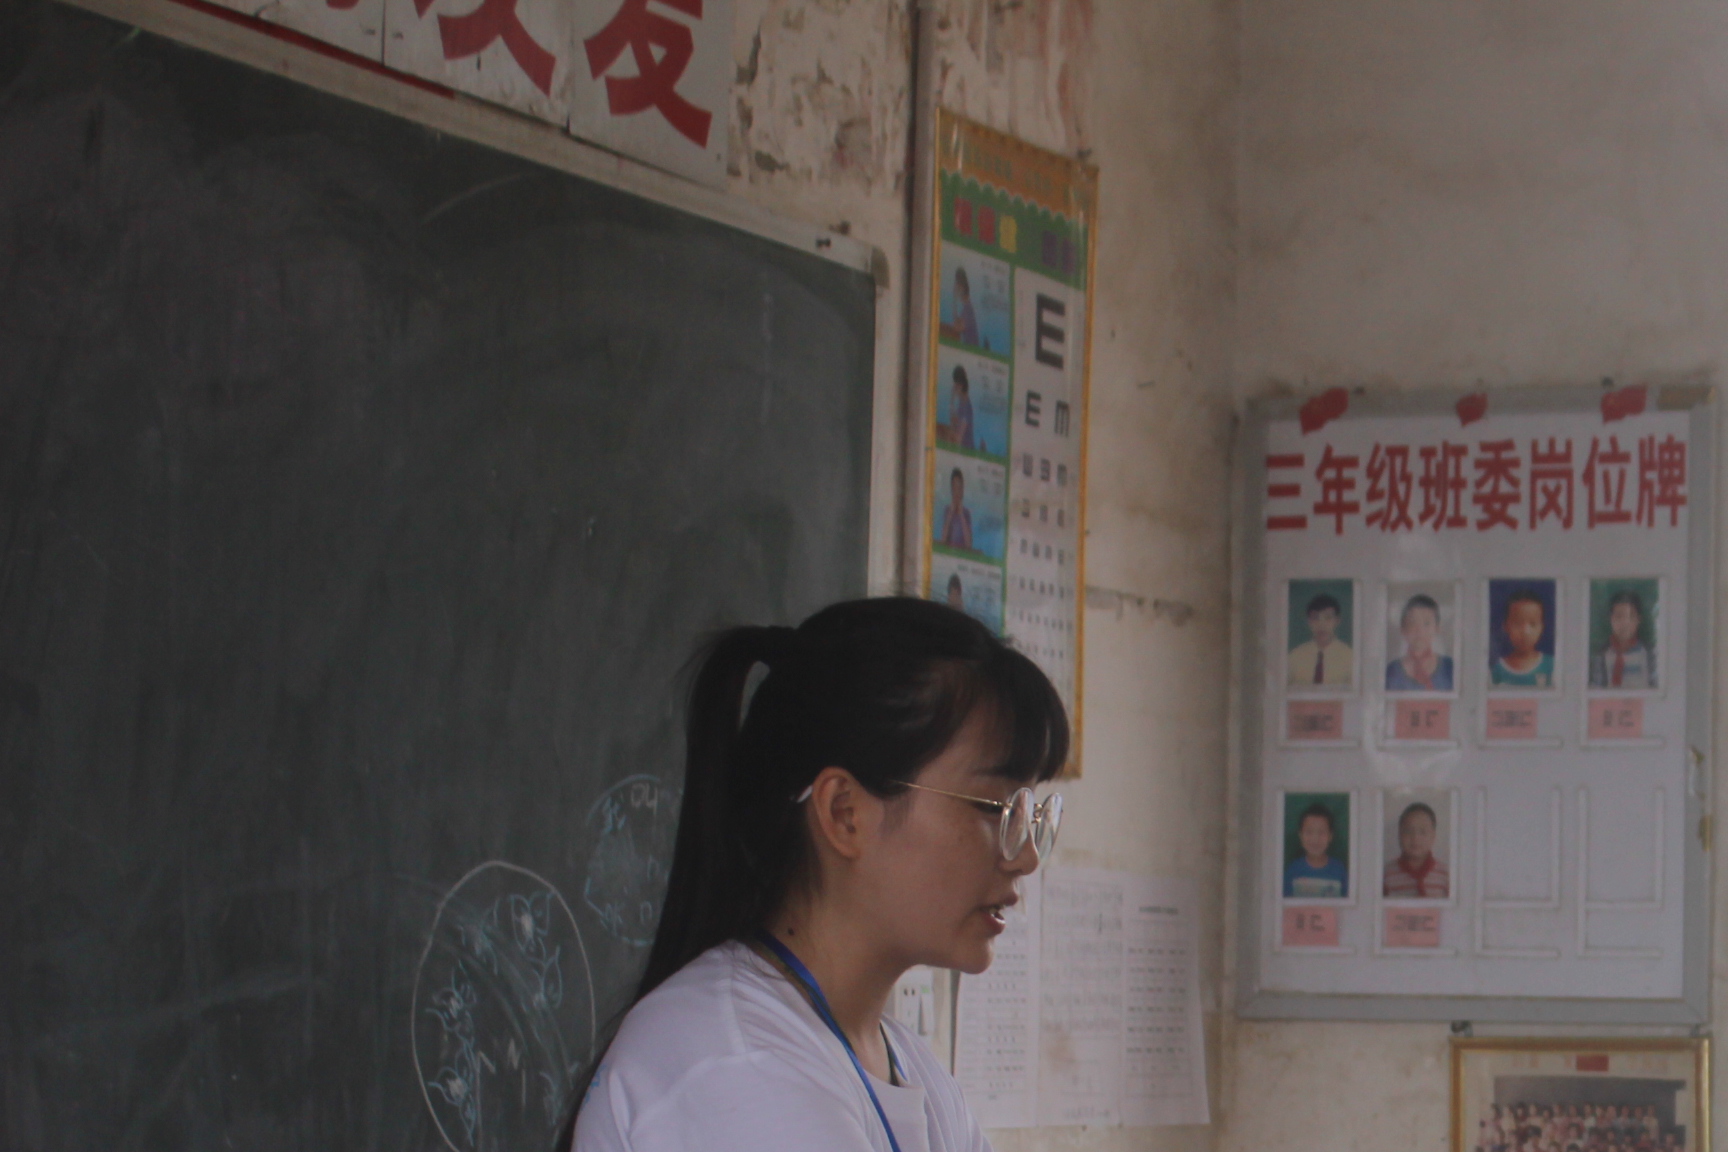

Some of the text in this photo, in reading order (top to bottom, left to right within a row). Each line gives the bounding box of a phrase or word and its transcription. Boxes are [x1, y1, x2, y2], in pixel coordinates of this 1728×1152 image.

[1265, 434, 1688, 535] 三年级班委岗位牌
